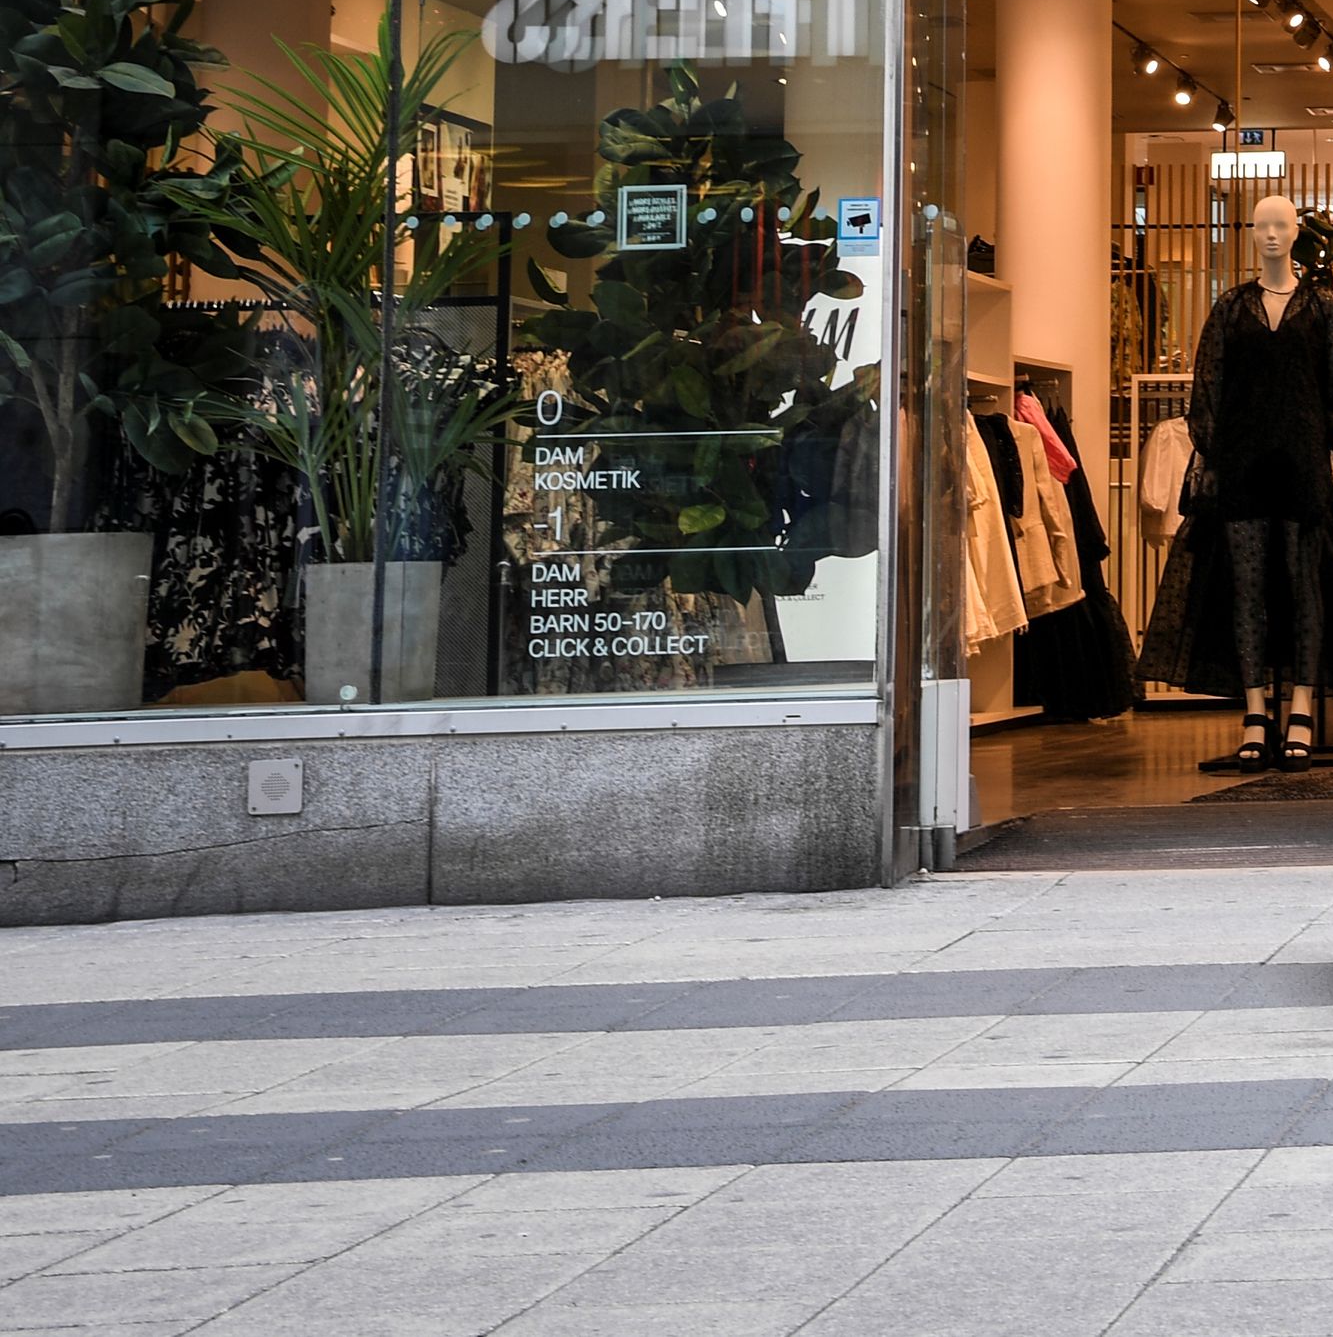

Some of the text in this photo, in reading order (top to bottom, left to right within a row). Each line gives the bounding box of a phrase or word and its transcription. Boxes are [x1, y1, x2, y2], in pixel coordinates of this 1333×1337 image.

[534, 446, 584, 466] DAM
[534, 469, 642, 491] KOSMETIK
[533, 506, 563, 542] -1
[531, 563, 581, 583] DAM
[530, 588, 588, 609] HERR
[529, 614, 590, 635] BARN
[528, 635, 710, 659] CLICK & COLLECT
